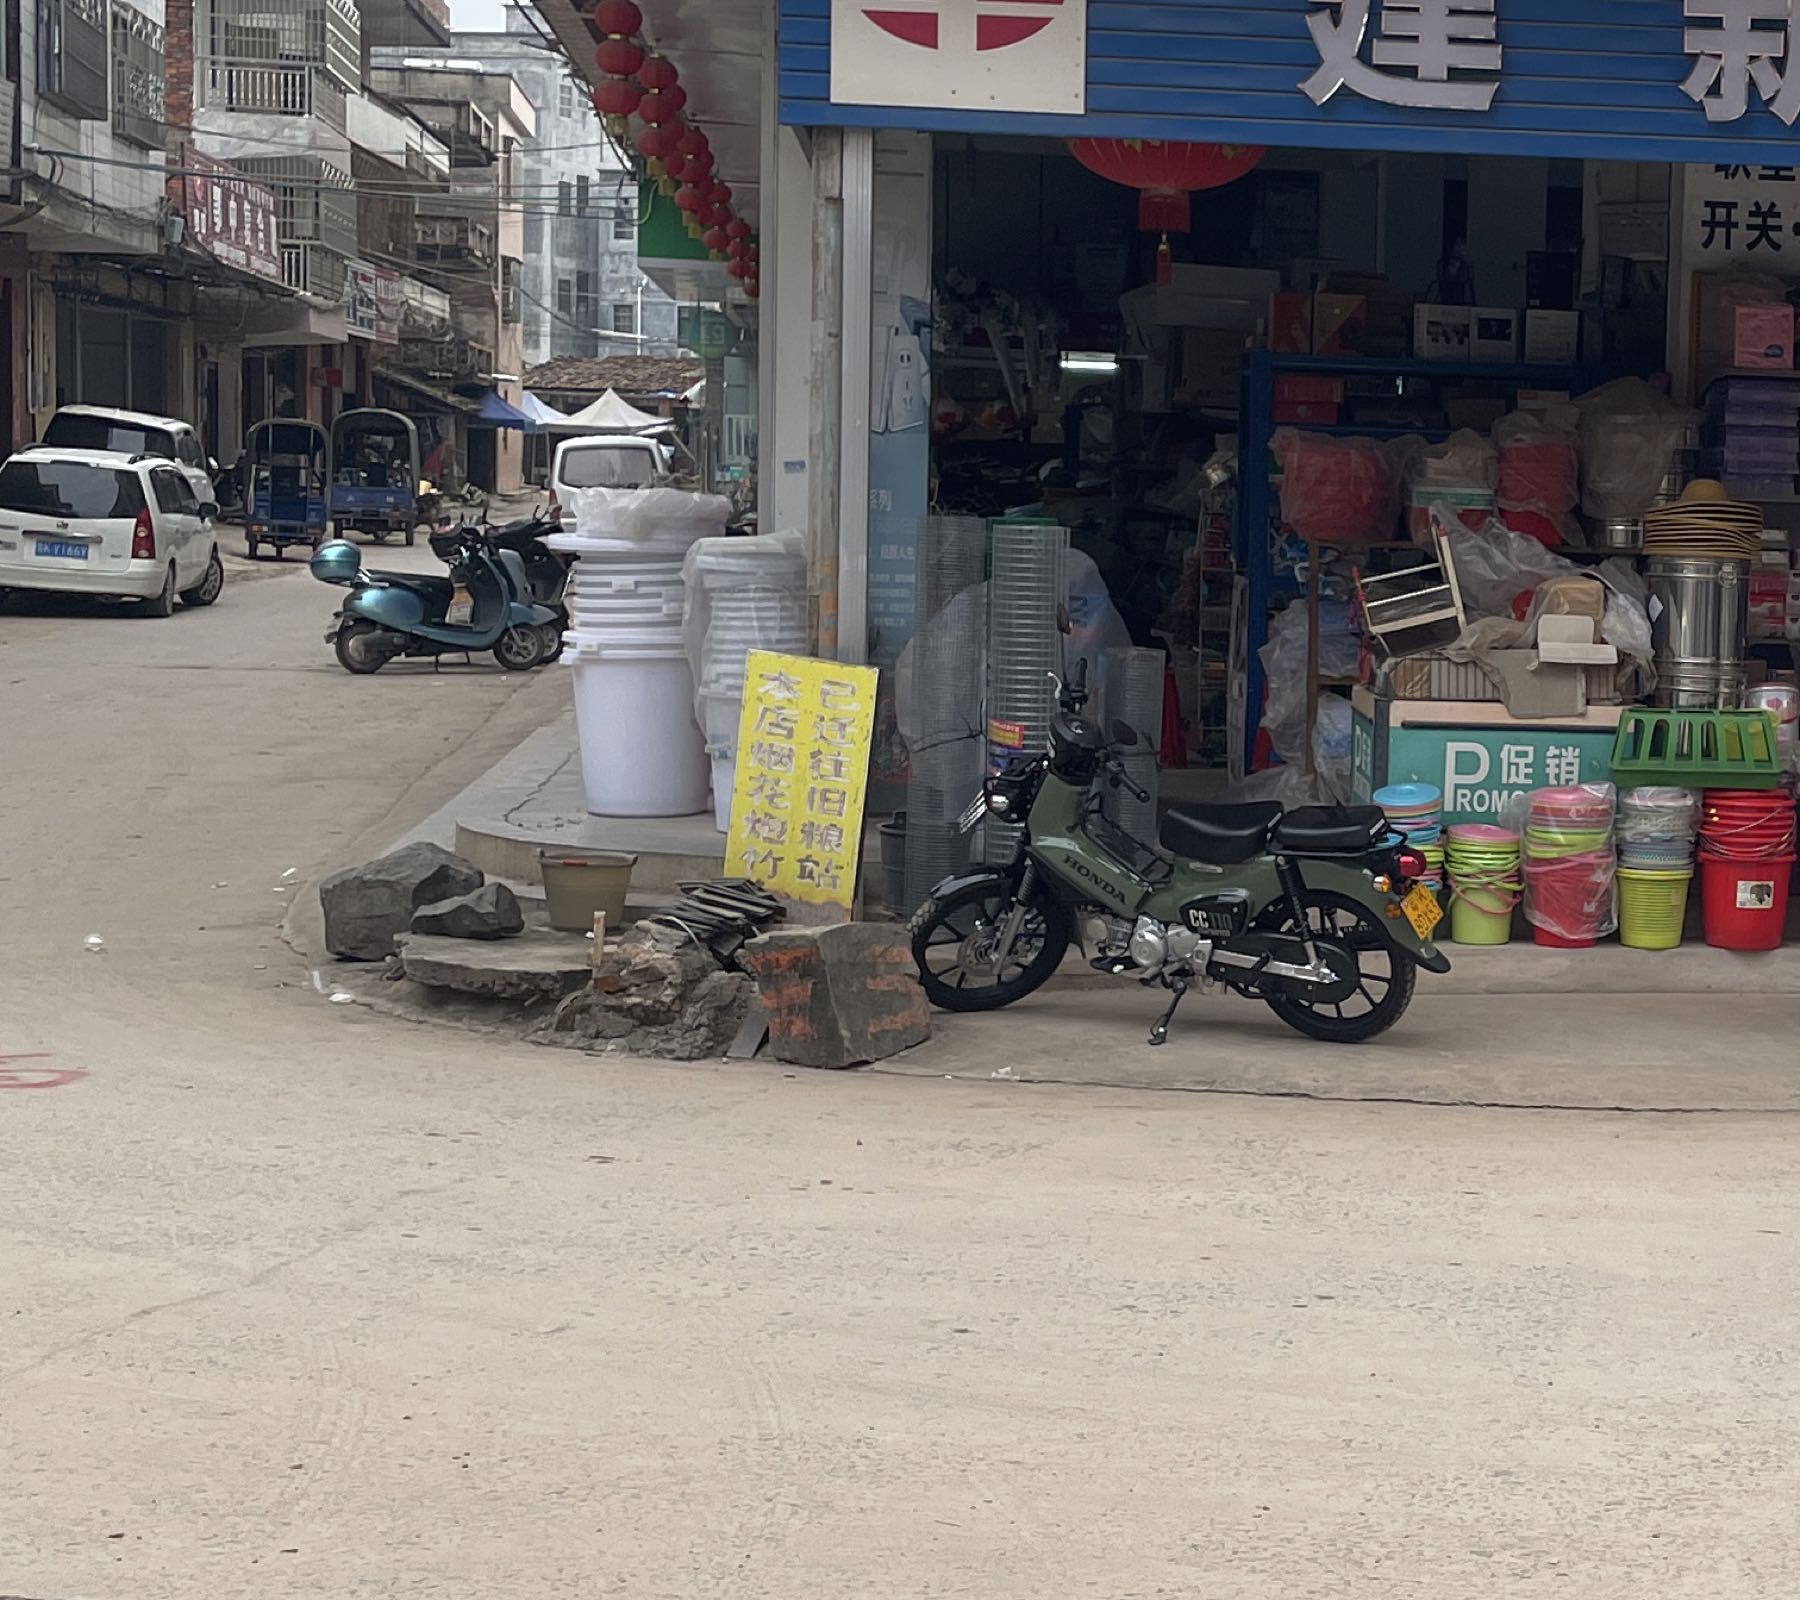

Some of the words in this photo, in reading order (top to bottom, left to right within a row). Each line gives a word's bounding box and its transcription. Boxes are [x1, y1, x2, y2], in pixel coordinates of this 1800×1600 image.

[1443, 741, 1526, 813] PROM
[1500, 743, 1581, 787] 促销
[1063, 854, 1128, 906] HONDA
